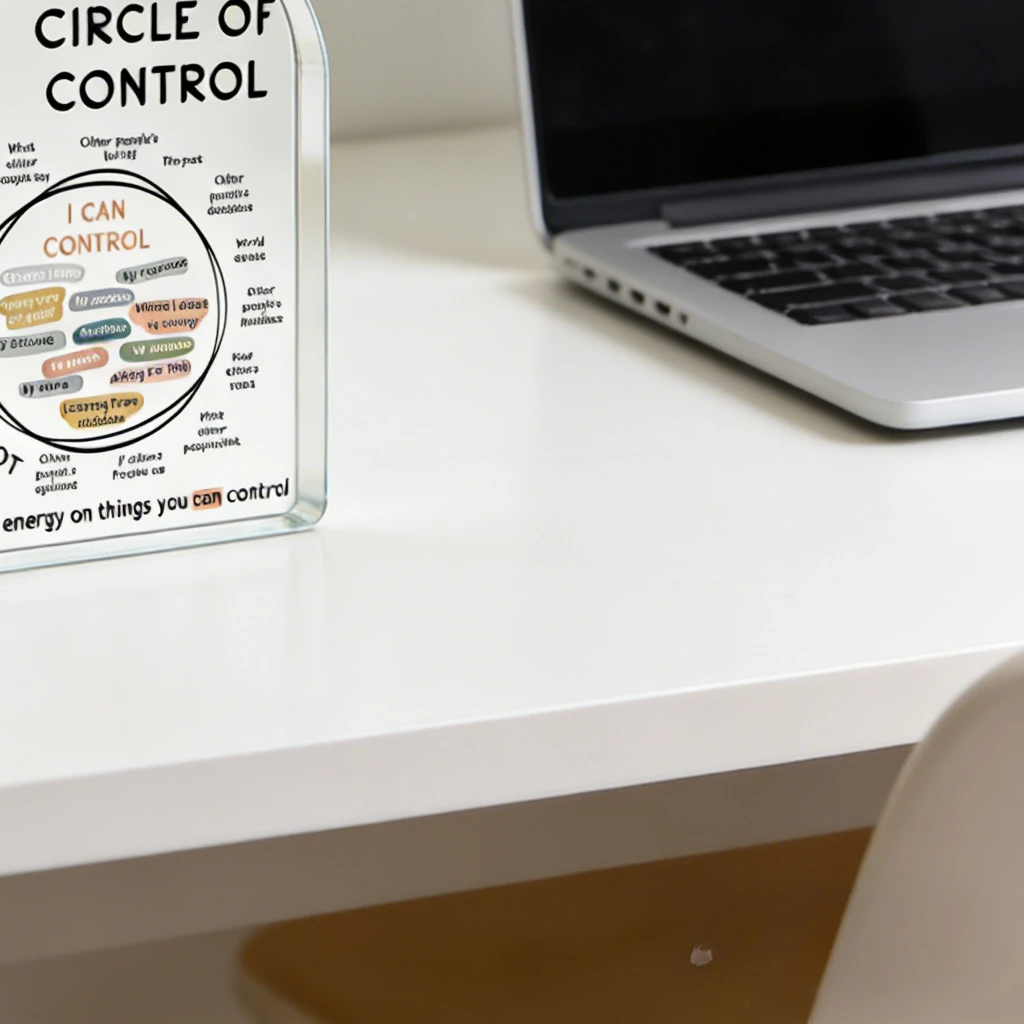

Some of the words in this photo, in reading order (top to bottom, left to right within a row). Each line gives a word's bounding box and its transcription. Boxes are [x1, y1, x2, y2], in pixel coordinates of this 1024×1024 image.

[35, 0, 199, 49] CIRCLE
[46, 60, 267, 112] CONTROL
[68, 203, 72, 224] I
[81, 199, 125, 222] CAN
[43, 228, 150, 258] CONTROL
[3, 511, 64, 532] energy
[70, 508, 92, 523] on
[99, 499, 151, 521] things
[157, 495, 188, 517] you
[193, 490, 222, 506] can
[227, 478, 289, 503] control
